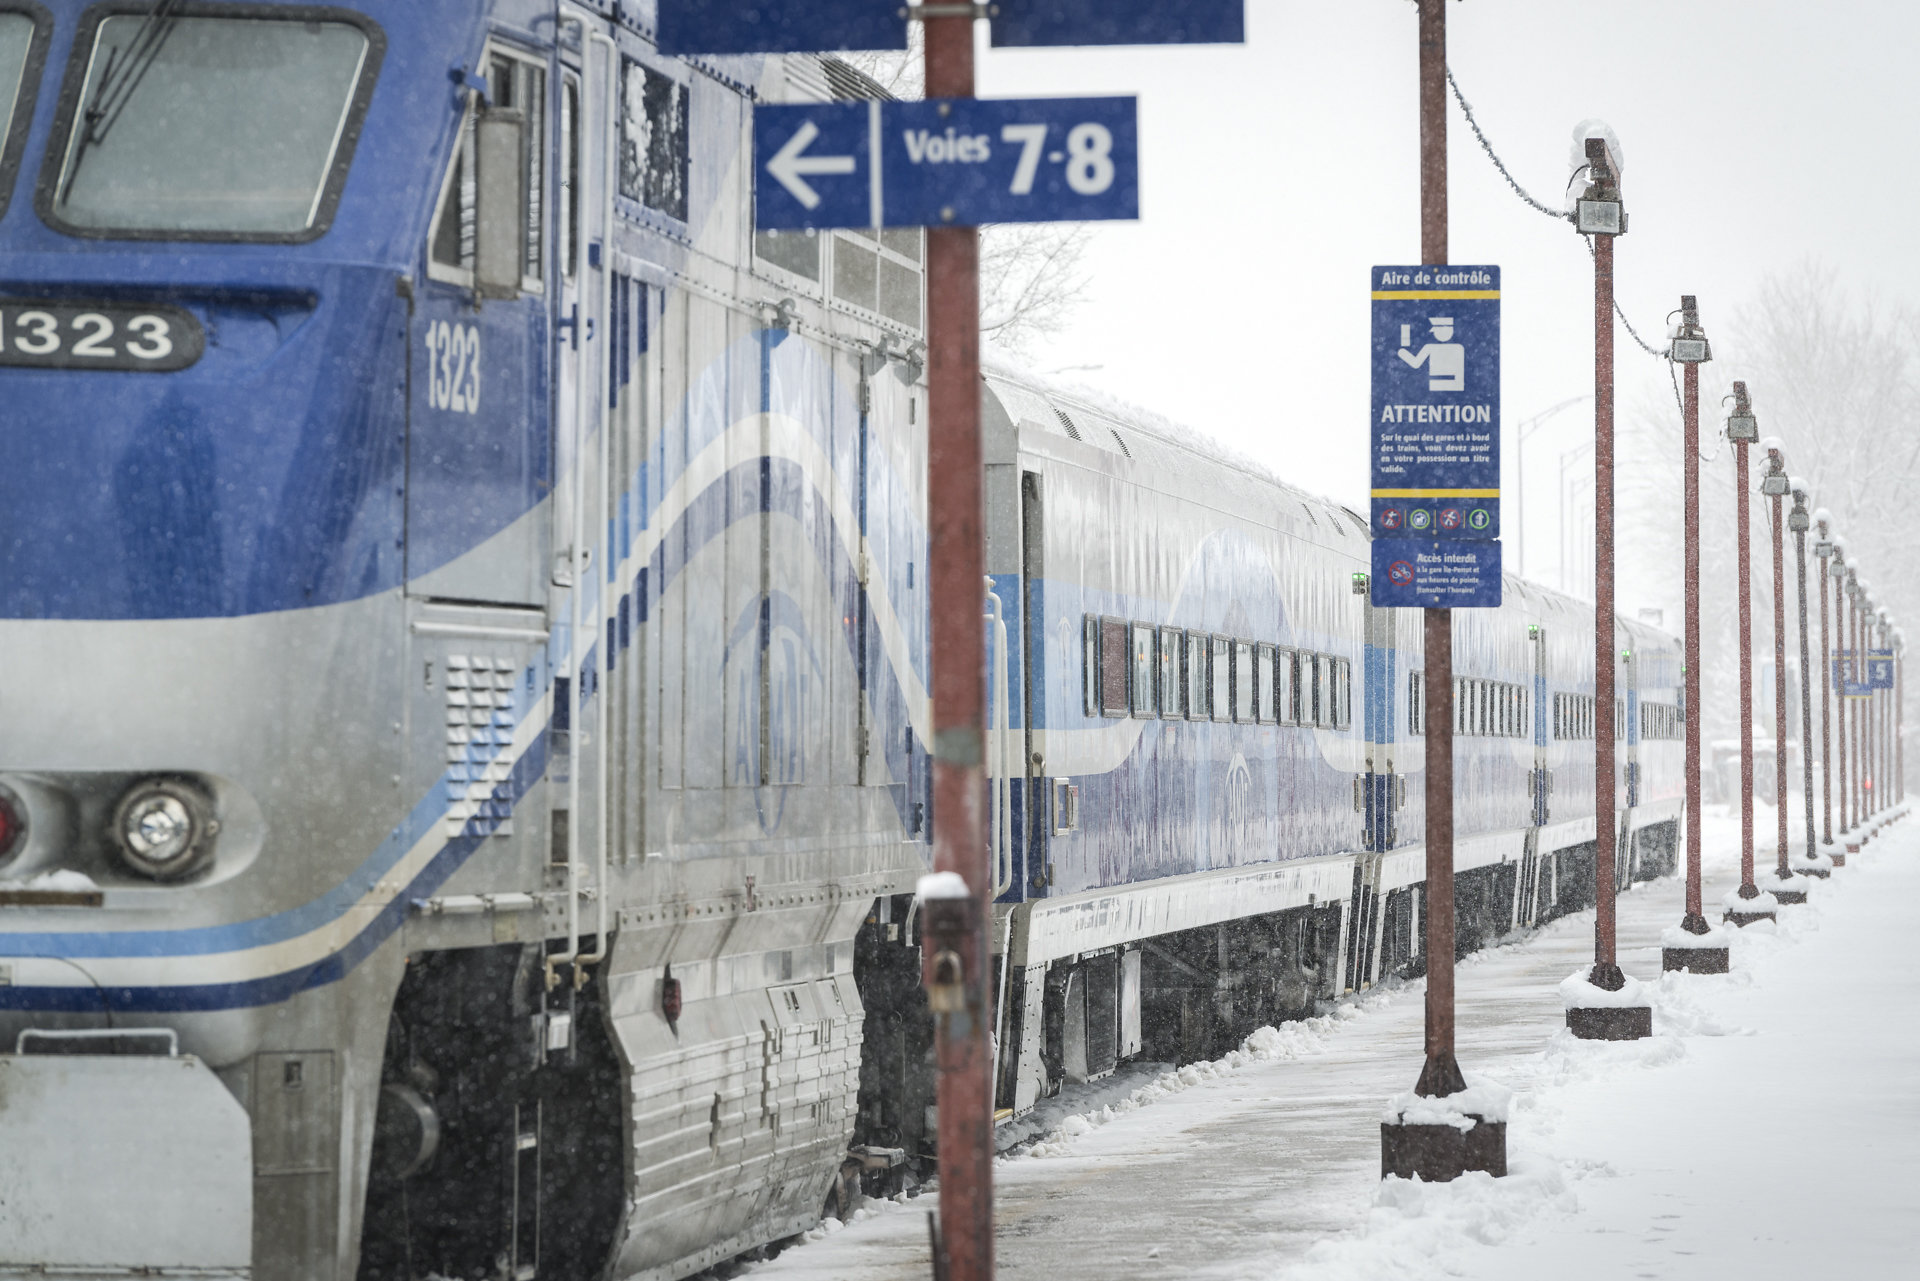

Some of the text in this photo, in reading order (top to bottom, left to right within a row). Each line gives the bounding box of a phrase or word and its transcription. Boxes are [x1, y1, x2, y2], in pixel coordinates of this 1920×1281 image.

[904, 122, 1116, 196] Voies 7-8
[1381, 271, 1491, 285] Aire de contrôle
[0, 310, 173, 360] 323
[425, 319, 480, 415] 1323
[1380, 404, 1491, 423] ATTENTION
[1381, 433, 1490, 443] Sur le quai des gares et à bord
[1381, 444, 1394, 452] des
[1397, 444, 1421, 453] trains,
[1445, 444, 1467, 452] devez
[1470, 443, 1490, 452] avoir
[1394, 455, 1414, 463] votre
[1417, 454, 1457, 464] possession
[1473, 454, 1490, 463] titre
[1381, 464, 1406, 473] valide.
[1416, 552, 1477, 563] Accès interdit
[1422, 565, 1428, 573] la
[1459, 576, 1479, 584] pointe
[1875, 662, 1886, 680] 5
